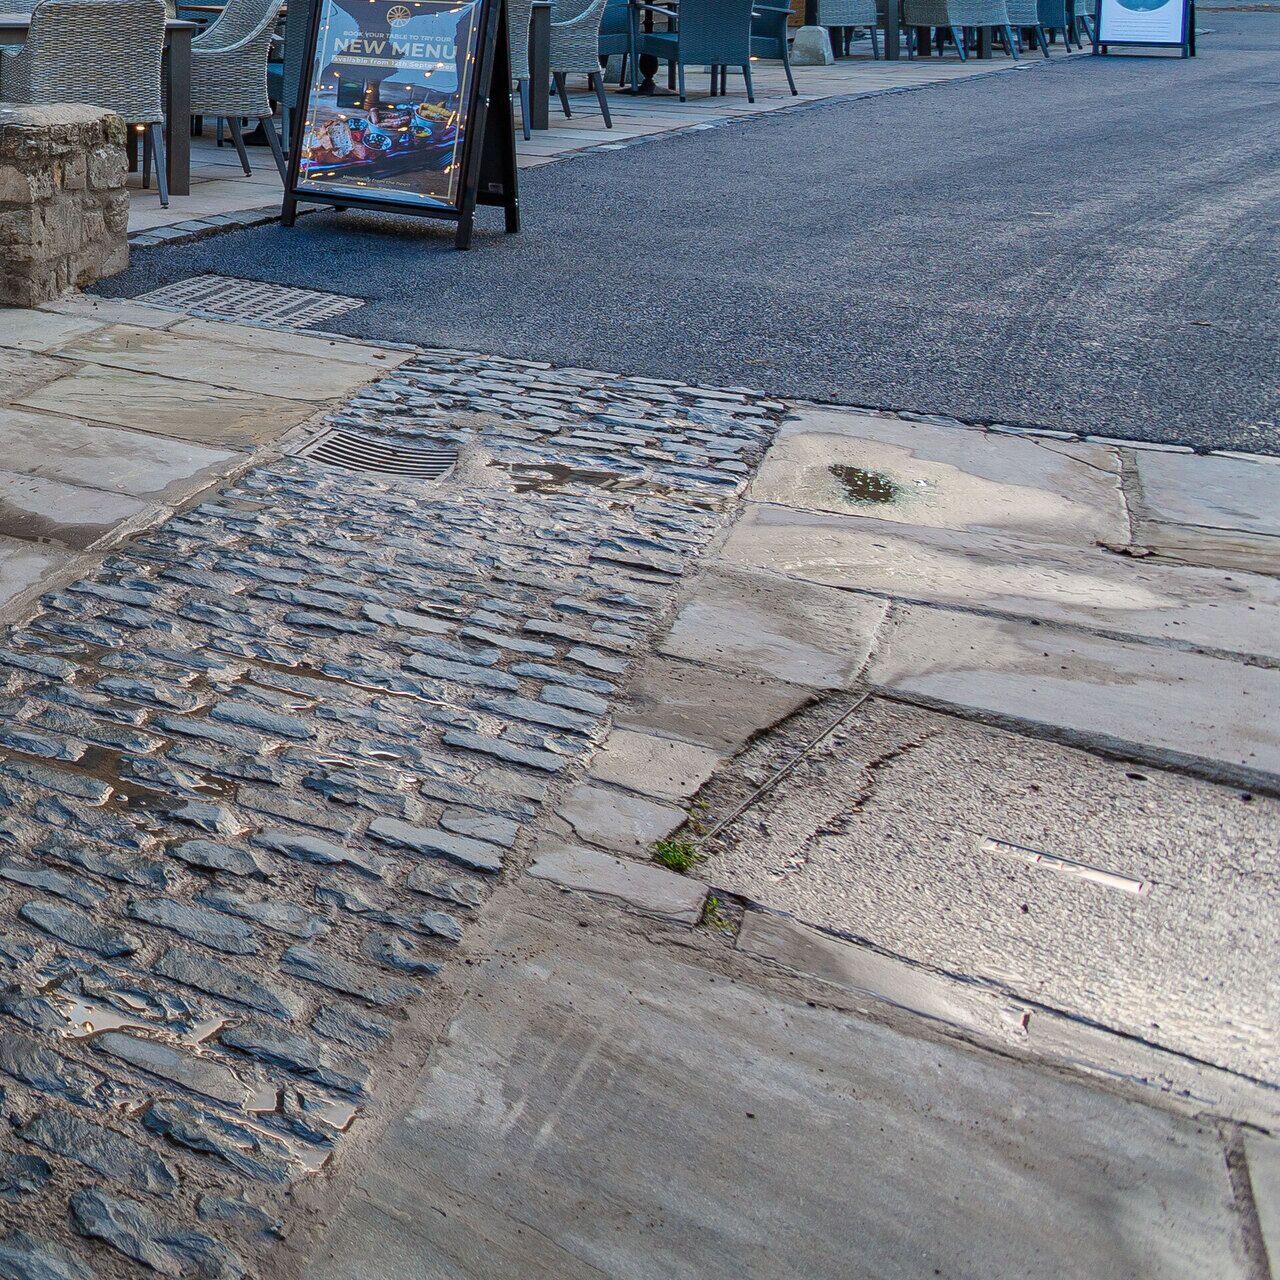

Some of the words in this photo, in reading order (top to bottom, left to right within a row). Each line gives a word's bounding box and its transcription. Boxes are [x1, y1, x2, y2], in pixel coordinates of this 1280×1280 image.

[365, 31, 385, 39] YOUR
[334, 38, 386, 55] NEW
[392, 41, 458, 60] MENU
[370, 58, 389, 66] from
[409, 61, 454, 70] Septeer
